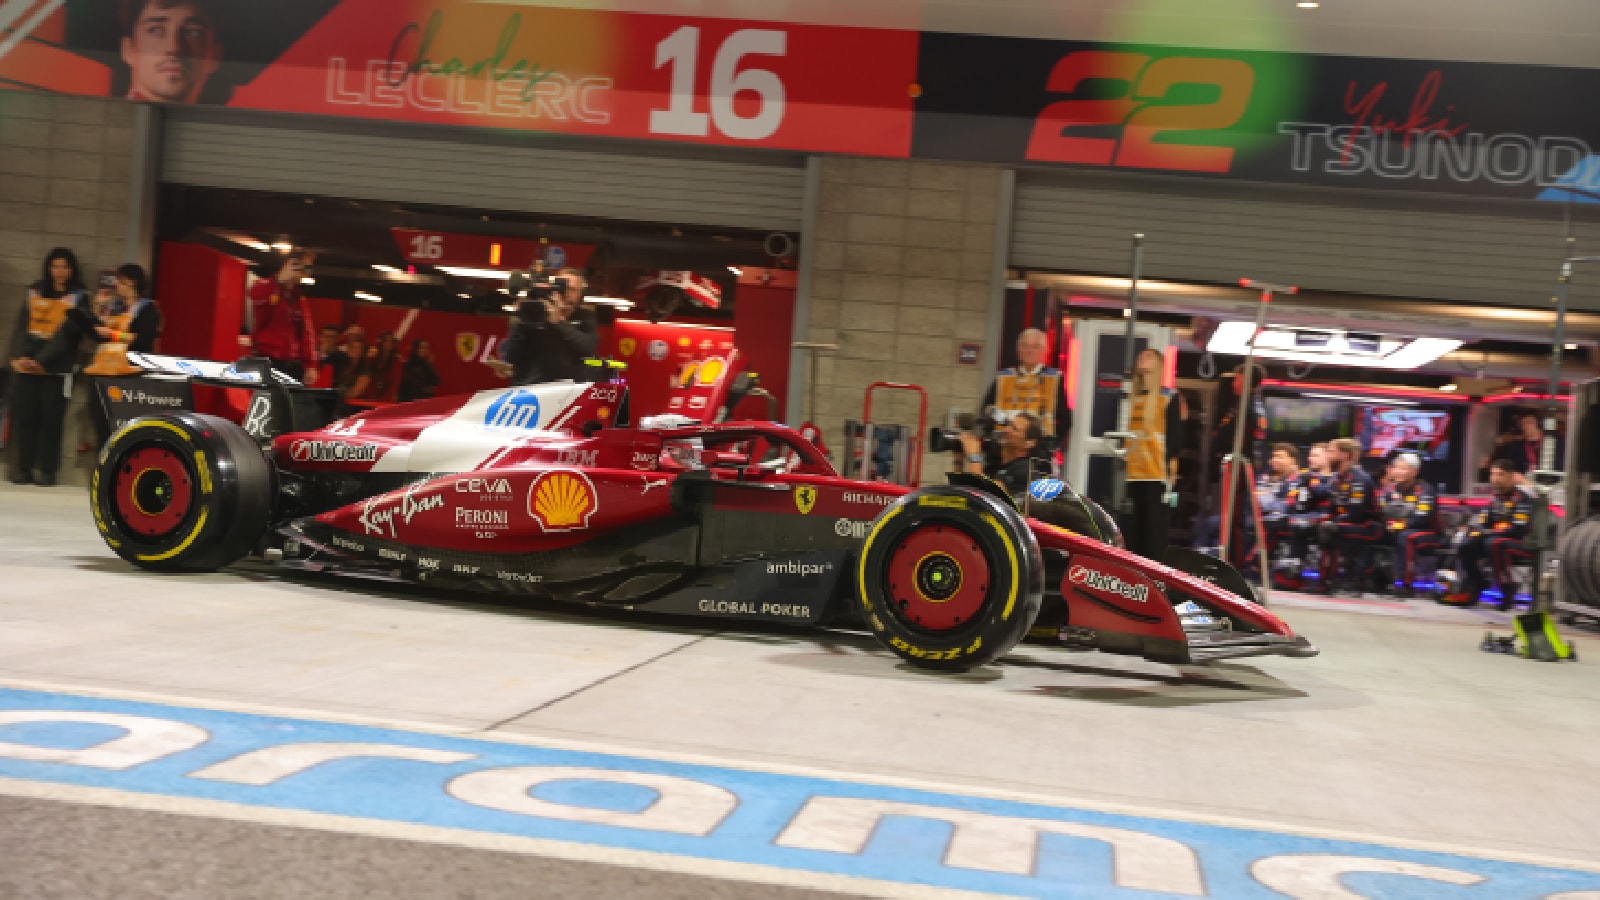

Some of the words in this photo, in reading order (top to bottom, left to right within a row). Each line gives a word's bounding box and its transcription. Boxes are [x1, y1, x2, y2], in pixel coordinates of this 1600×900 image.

[325, 57, 613, 125] LECLERC
[649, 26, 788, 139] 16
[1025, 51, 1255, 173] 22
[1339, 69, 1469, 167] Yuki
[409, 235, 444, 259] 16
[309, 440, 378, 461] UniCredit
[455, 478, 512, 493] CEVA
[842, 491, 899, 506] RICHAR
[358, 472, 446, 538] Ray-Ban
[455, 506, 508, 524] PERONI
[1086, 568, 1149, 603] UniCredit
[698, 599, 757, 615] GLOBAL
[760, 602, 811, 618] POKER
